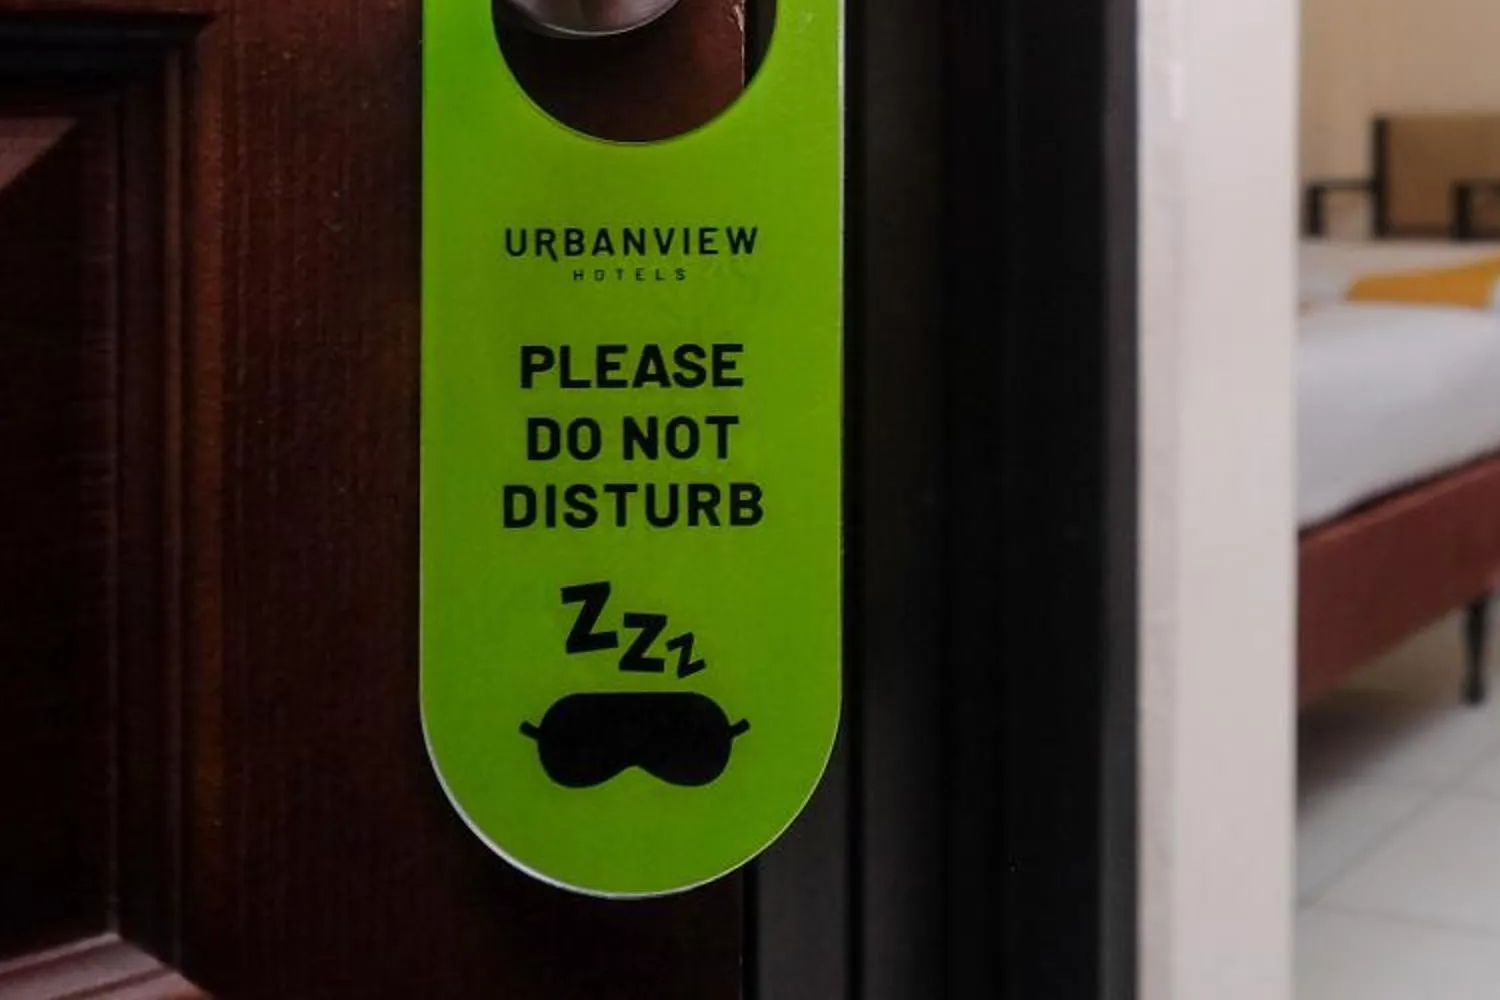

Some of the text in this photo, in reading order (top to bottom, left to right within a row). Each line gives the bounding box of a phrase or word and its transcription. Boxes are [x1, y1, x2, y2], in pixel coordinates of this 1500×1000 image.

[504, 225, 759, 264] URBANVIEW
[572, 267, 686, 282] HOTELS
[519, 342, 745, 391] PLEASE
[525, 414, 741, 463] DO NOT
[501, 481, 765, 530] DISTURB
